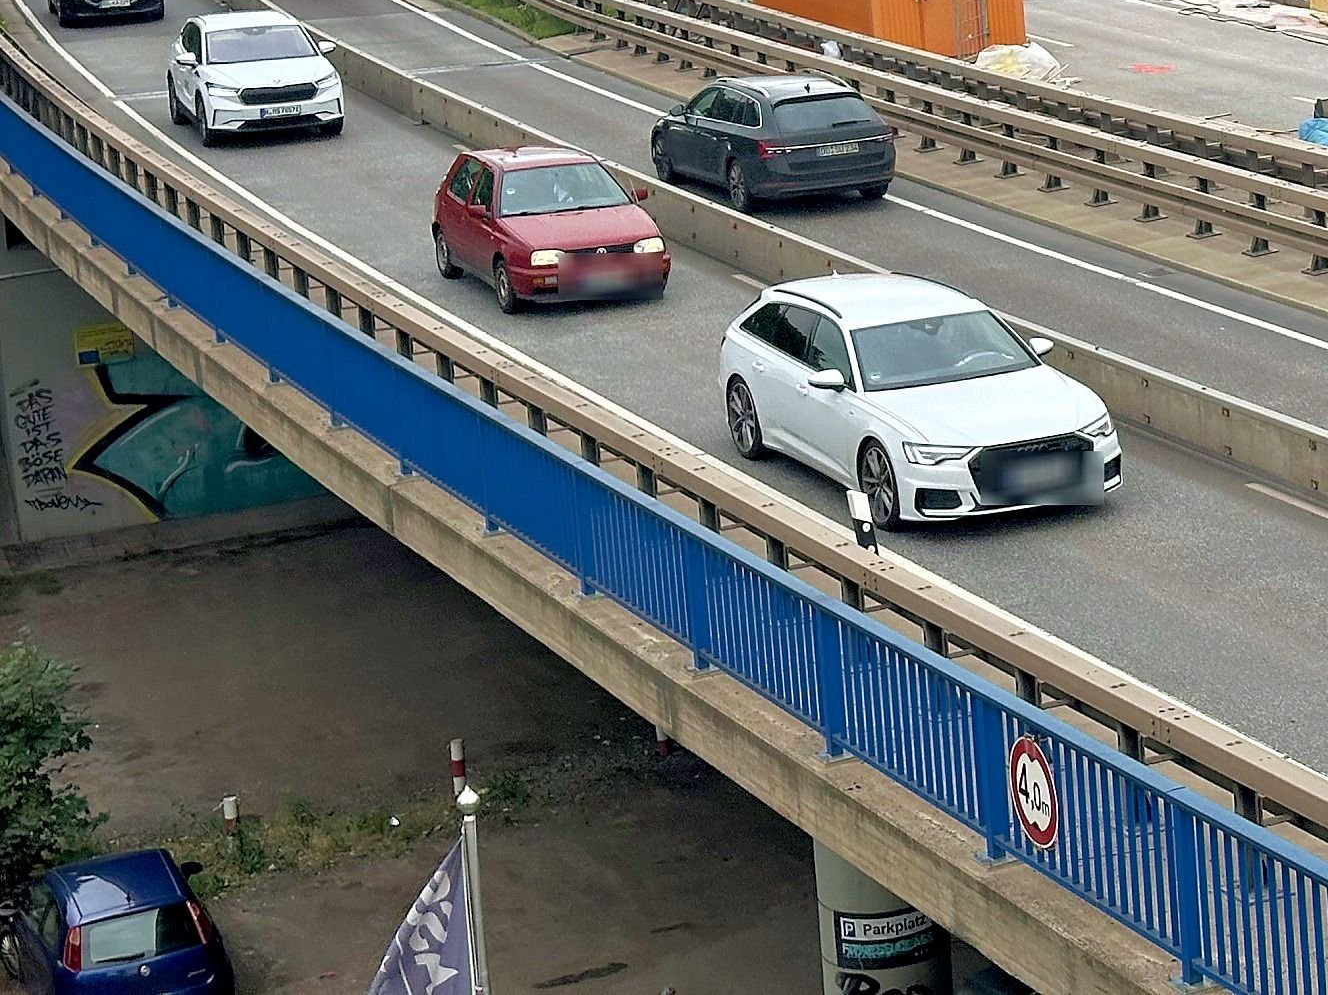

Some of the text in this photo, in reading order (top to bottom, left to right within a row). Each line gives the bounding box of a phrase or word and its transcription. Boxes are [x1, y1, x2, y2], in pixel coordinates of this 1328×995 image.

[17, 389, 53, 412] DAS
[19, 431, 63, 455] DAS
[863, 915, 926, 935] Parkplatz
